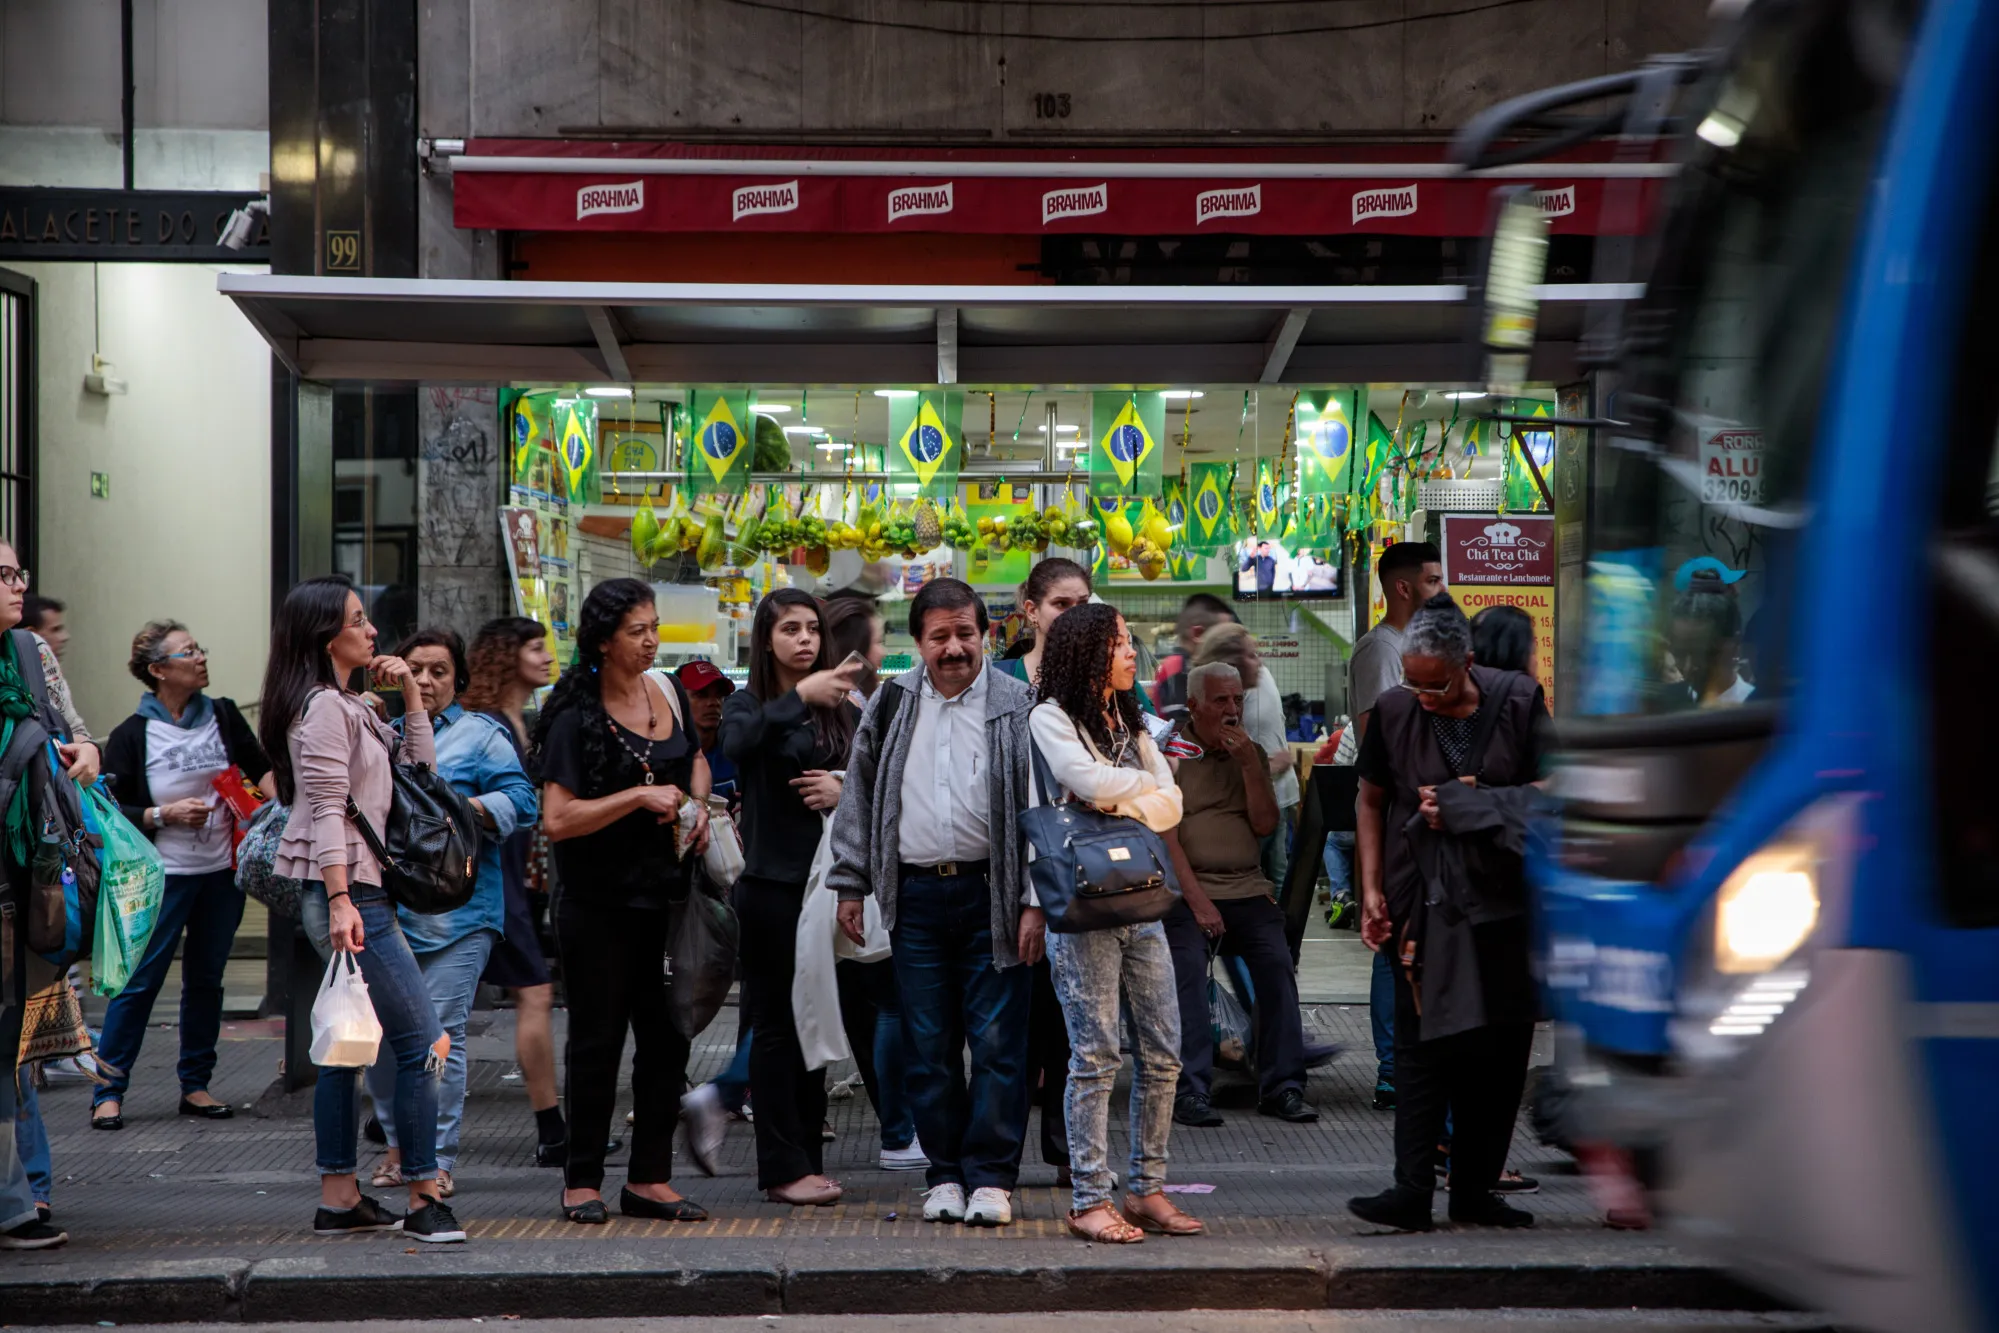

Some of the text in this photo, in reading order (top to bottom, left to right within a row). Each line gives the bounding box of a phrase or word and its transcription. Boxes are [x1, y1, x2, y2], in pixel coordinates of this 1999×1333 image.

[1035, 93, 1071, 118] 103
[582, 187, 641, 211] BRAHMA
[737, 188, 794, 212] BRAHMA
[892, 189, 949, 213] BRAHMA
[1046, 190, 1104, 215] BRAHMA
[1200, 191, 1257, 216] BRAHMA
[1356, 191, 1414, 216] BRAHMA
[1533, 192, 1572, 213] AHMA
[0, 207, 142, 243] ALACETE
[158, 209, 196, 243] DO
[331, 236, 357, 266] 99
[1707, 457, 1759, 477] ALU
[1466, 548, 1540, 560] Chá Tea Chá
[1458, 573, 1501, 582] Restaurante
[1509, 573, 1551, 583] Lanchonete
[1462, 594, 1548, 607] COMERCIAL
